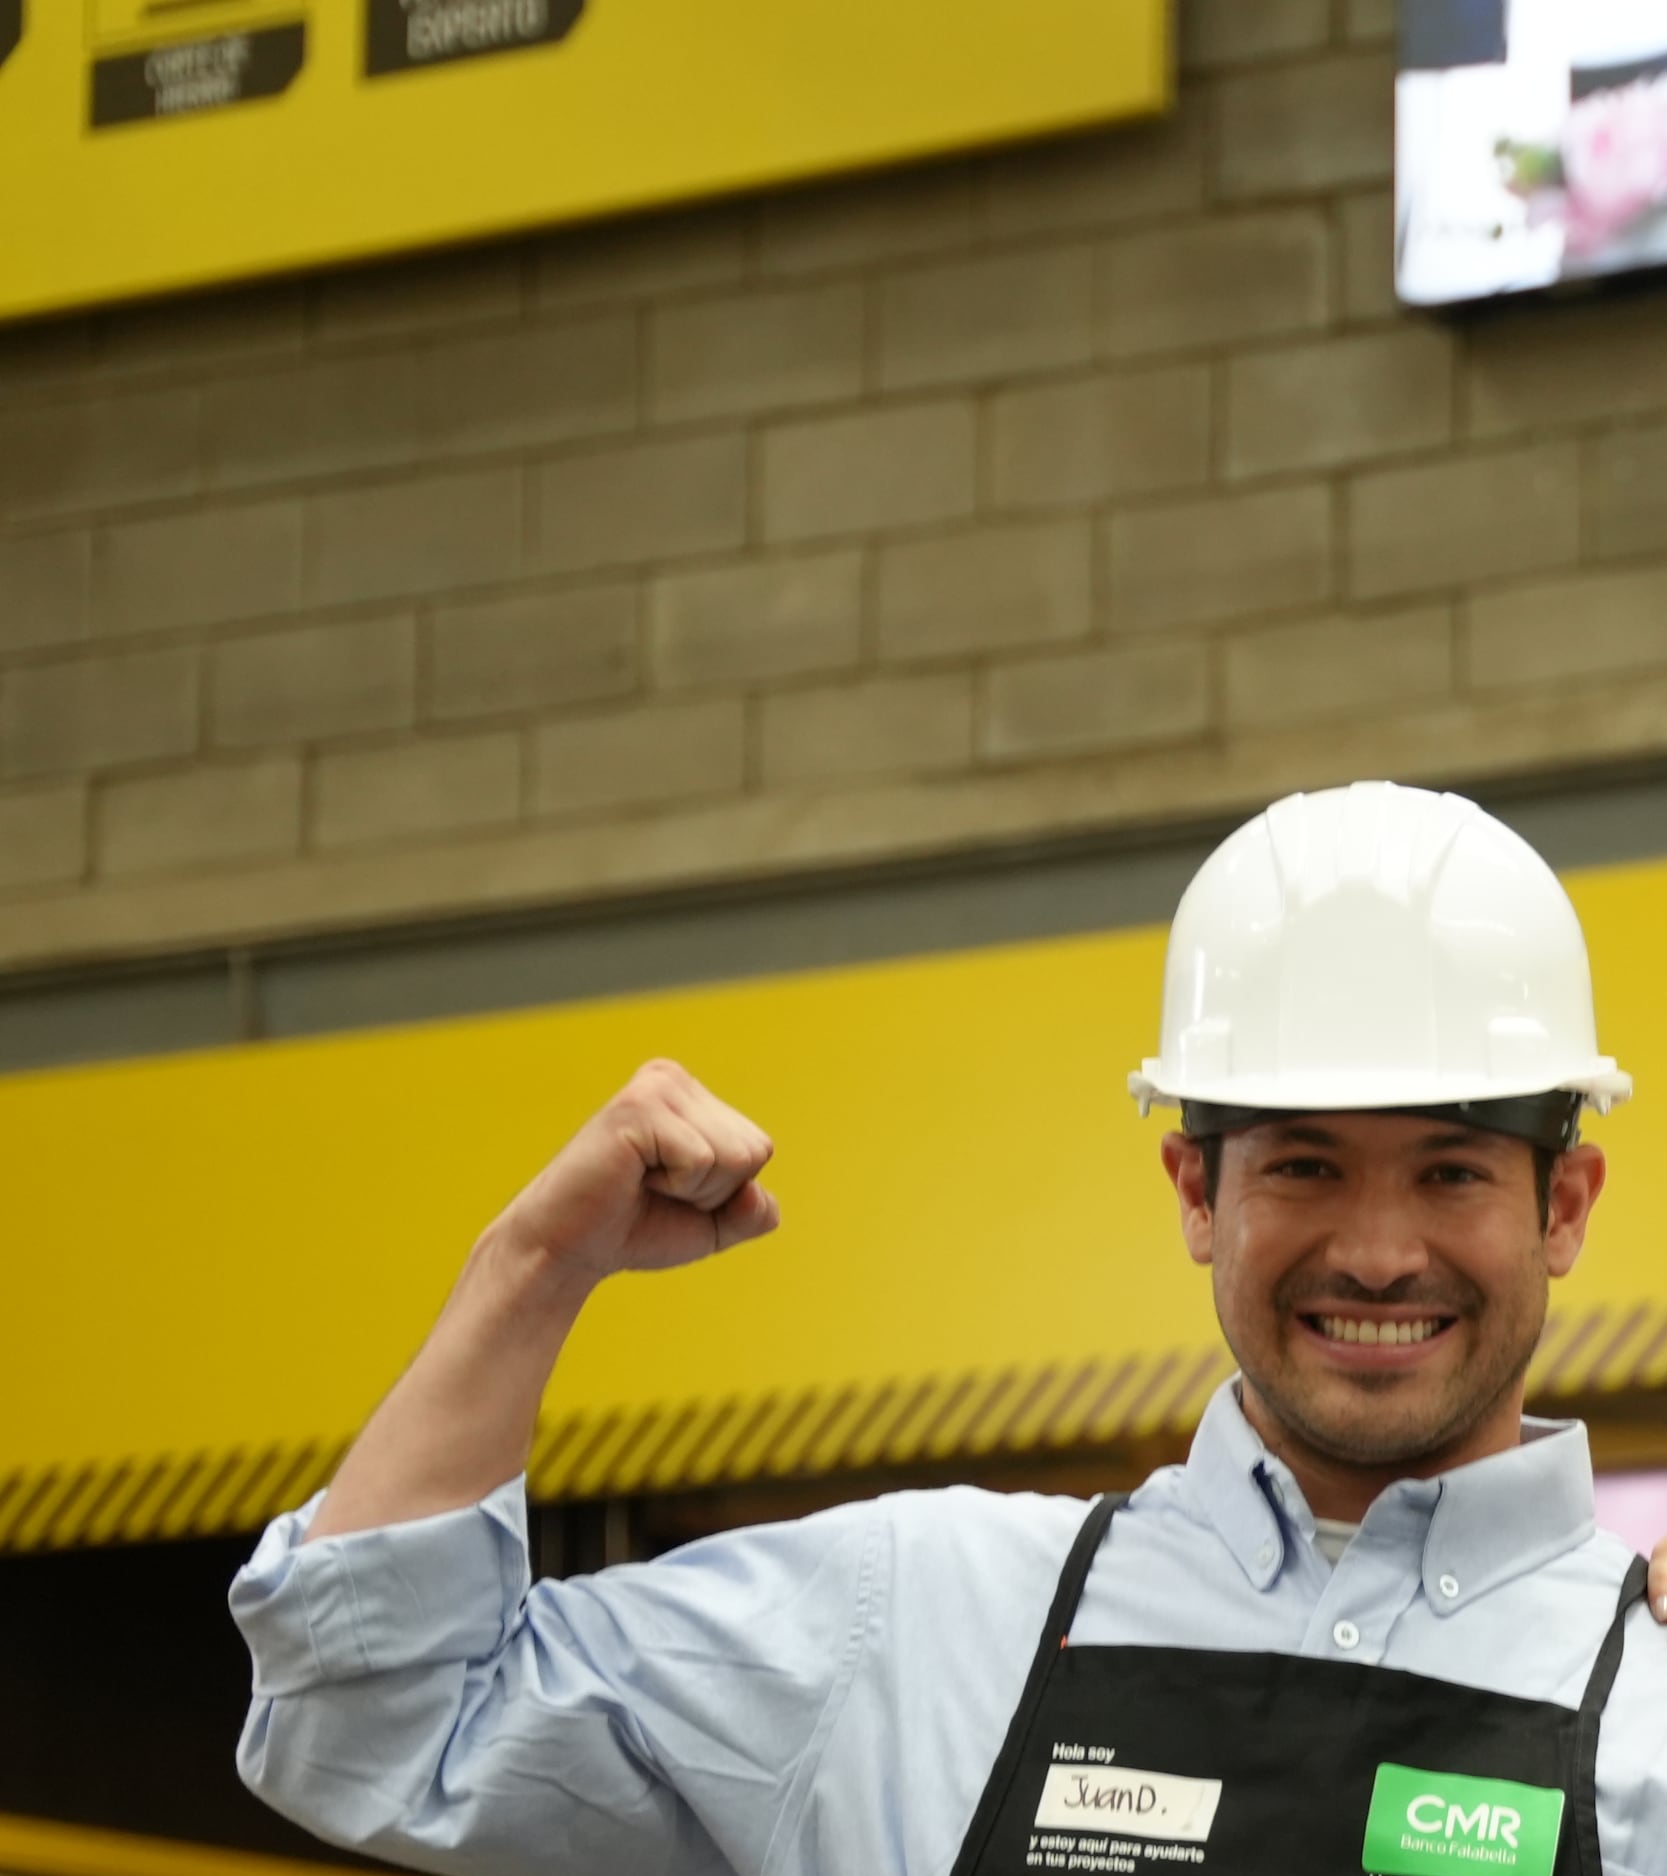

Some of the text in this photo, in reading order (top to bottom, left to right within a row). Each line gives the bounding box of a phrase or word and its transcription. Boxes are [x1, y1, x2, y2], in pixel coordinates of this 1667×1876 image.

[1052, 1742, 1115, 1764] Hola soy
[1407, 1794, 1521, 1849] CMR
[1026, 1852, 1136, 1873] en tus proyectos
[1029, 1835, 1205, 1863] y estoy aquí para ayudarte
[1401, 1833, 1517, 1866] Banco Falabella
